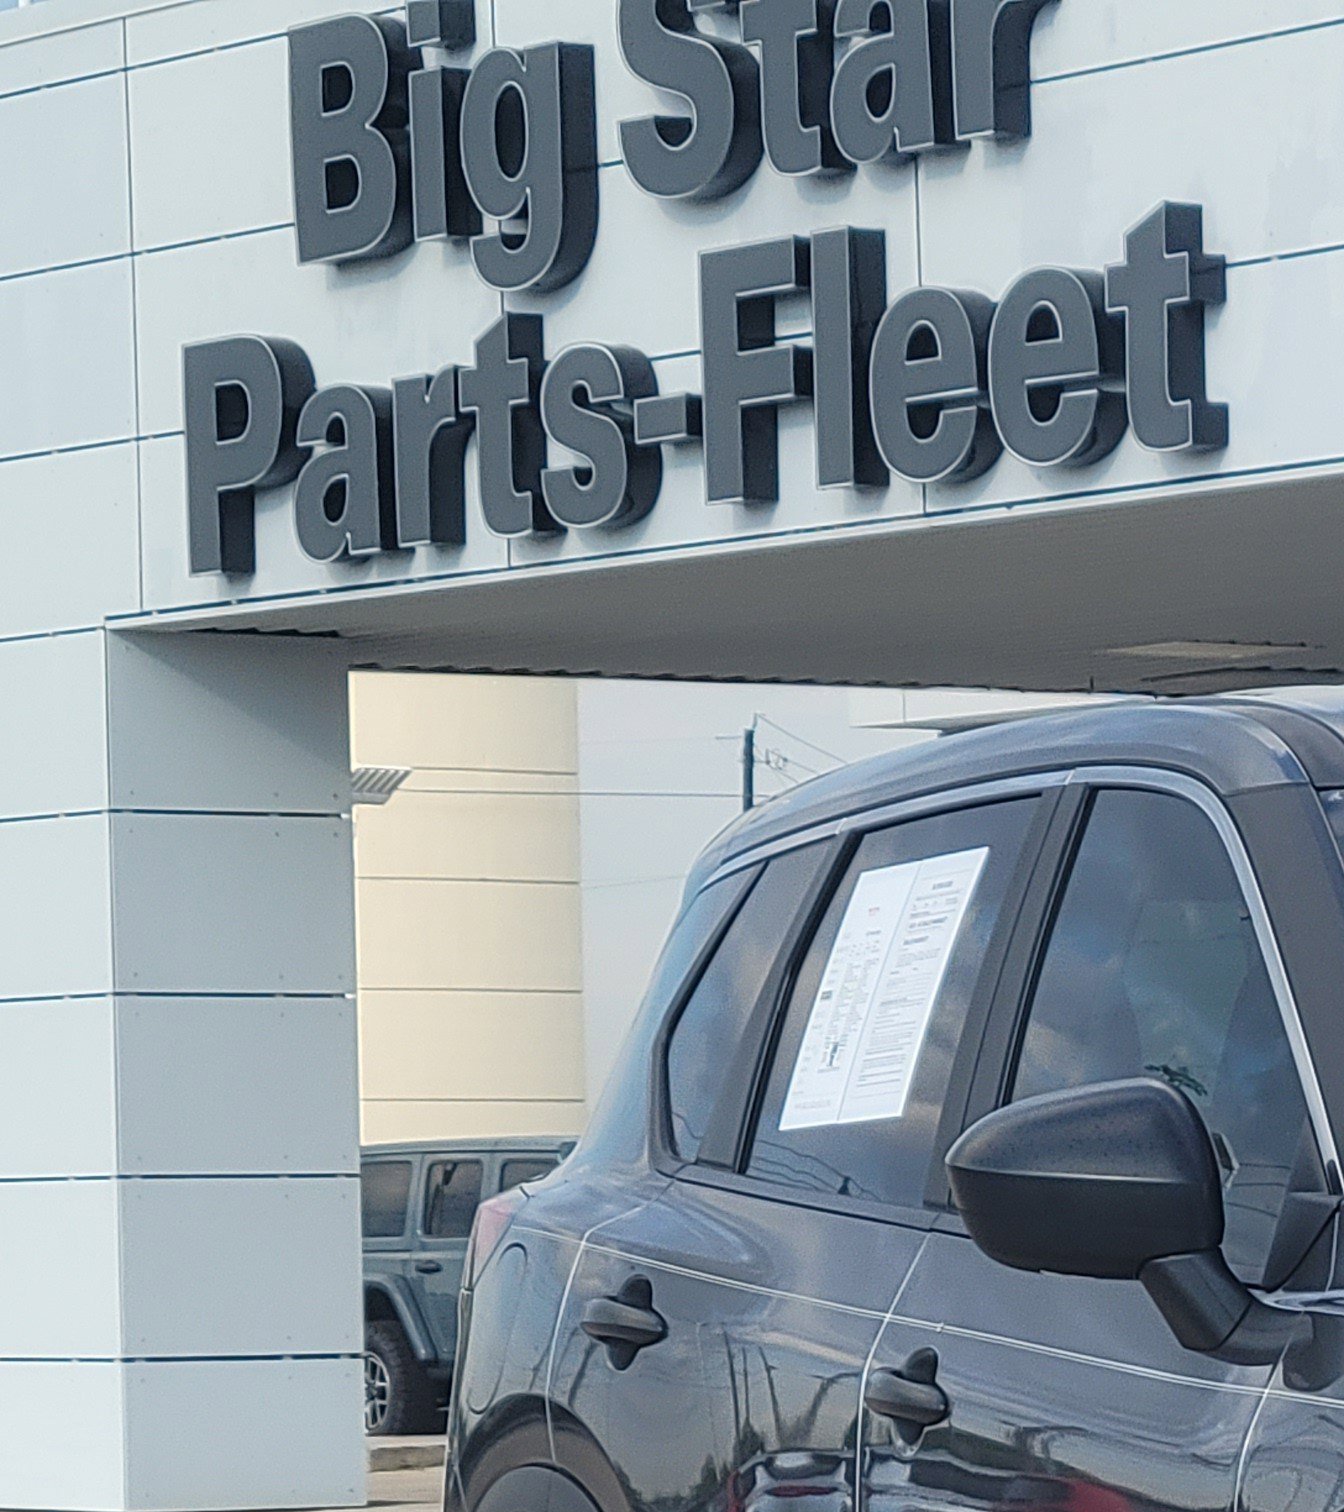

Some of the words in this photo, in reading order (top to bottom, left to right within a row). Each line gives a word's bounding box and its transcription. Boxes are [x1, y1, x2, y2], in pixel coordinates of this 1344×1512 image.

[287, 11, 597, 292] Big
[616, 0, 1060, 200] Star
[181, 200, 1229, 577] Parts-Fleet
